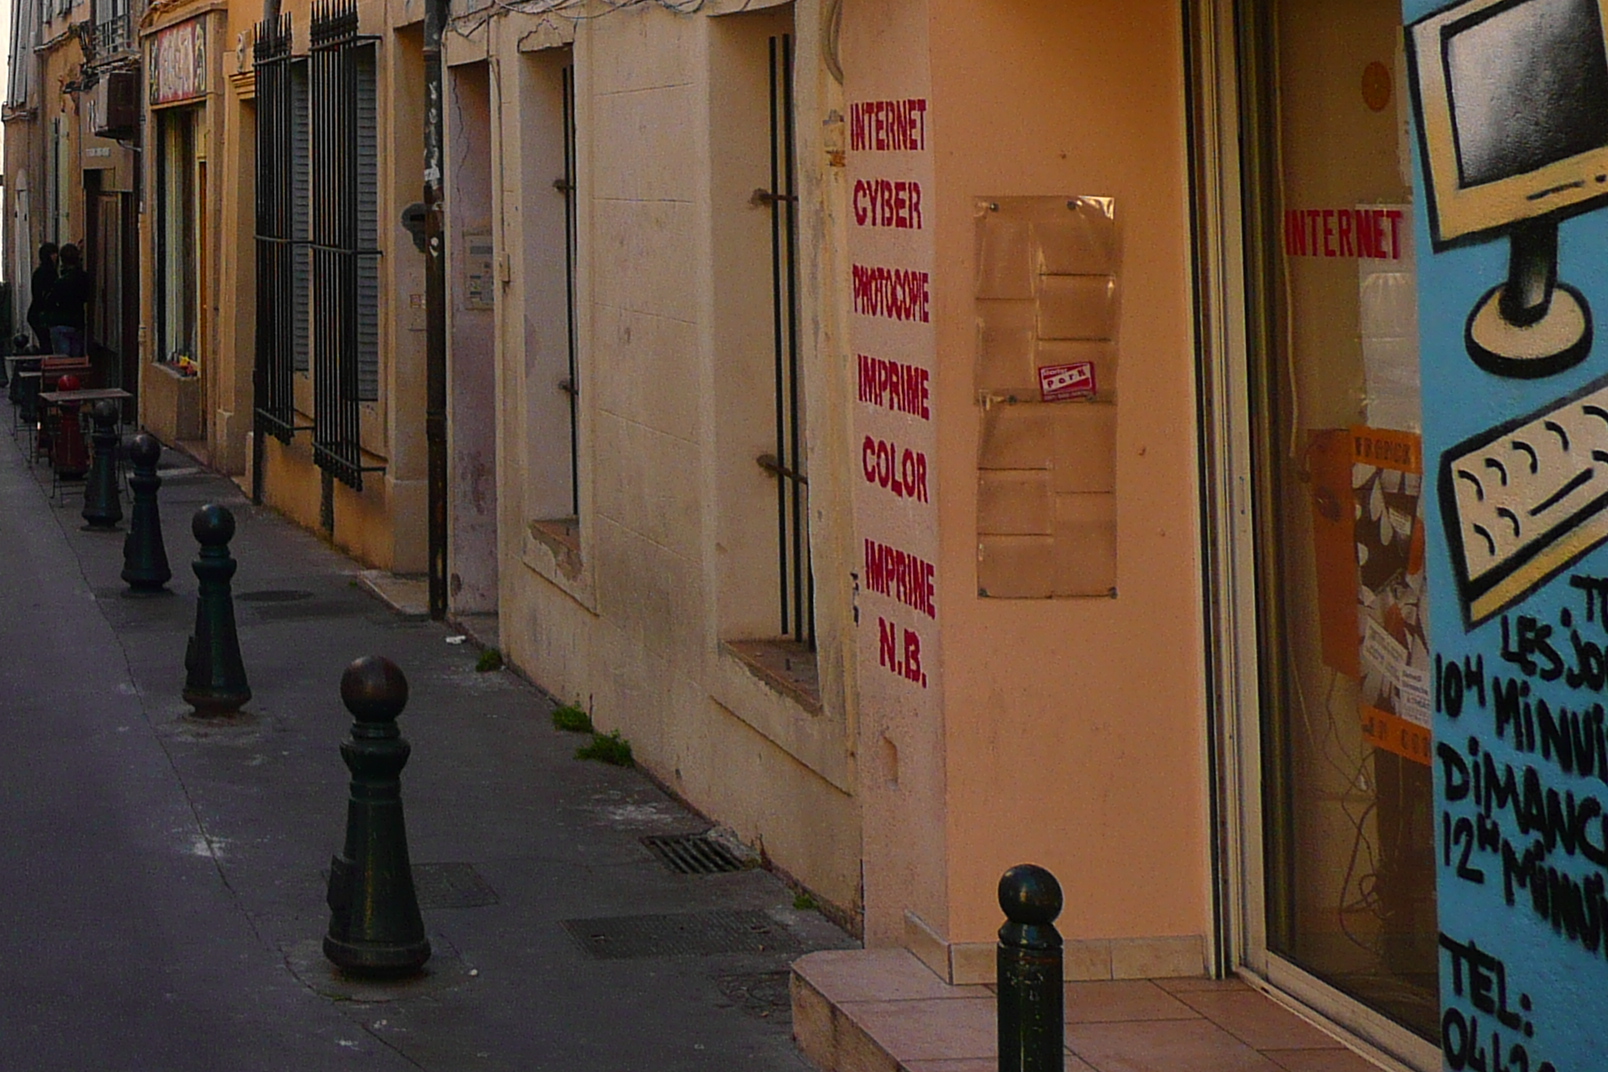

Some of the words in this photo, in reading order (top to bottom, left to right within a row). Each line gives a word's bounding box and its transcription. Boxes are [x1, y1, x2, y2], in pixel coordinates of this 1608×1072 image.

[850, 99, 927, 151] INTERNET
[853, 178, 923, 229] CYBER
[1284, 209, 1403, 260] INTERNET
[852, 263, 930, 323] PHOTOCOPIE
[857, 353, 930, 421] IMPRIME
[862, 435, 929, 504] COLOR
[878, 616, 927, 689] N.B.
[1501, 614, 1565, 682] LES
